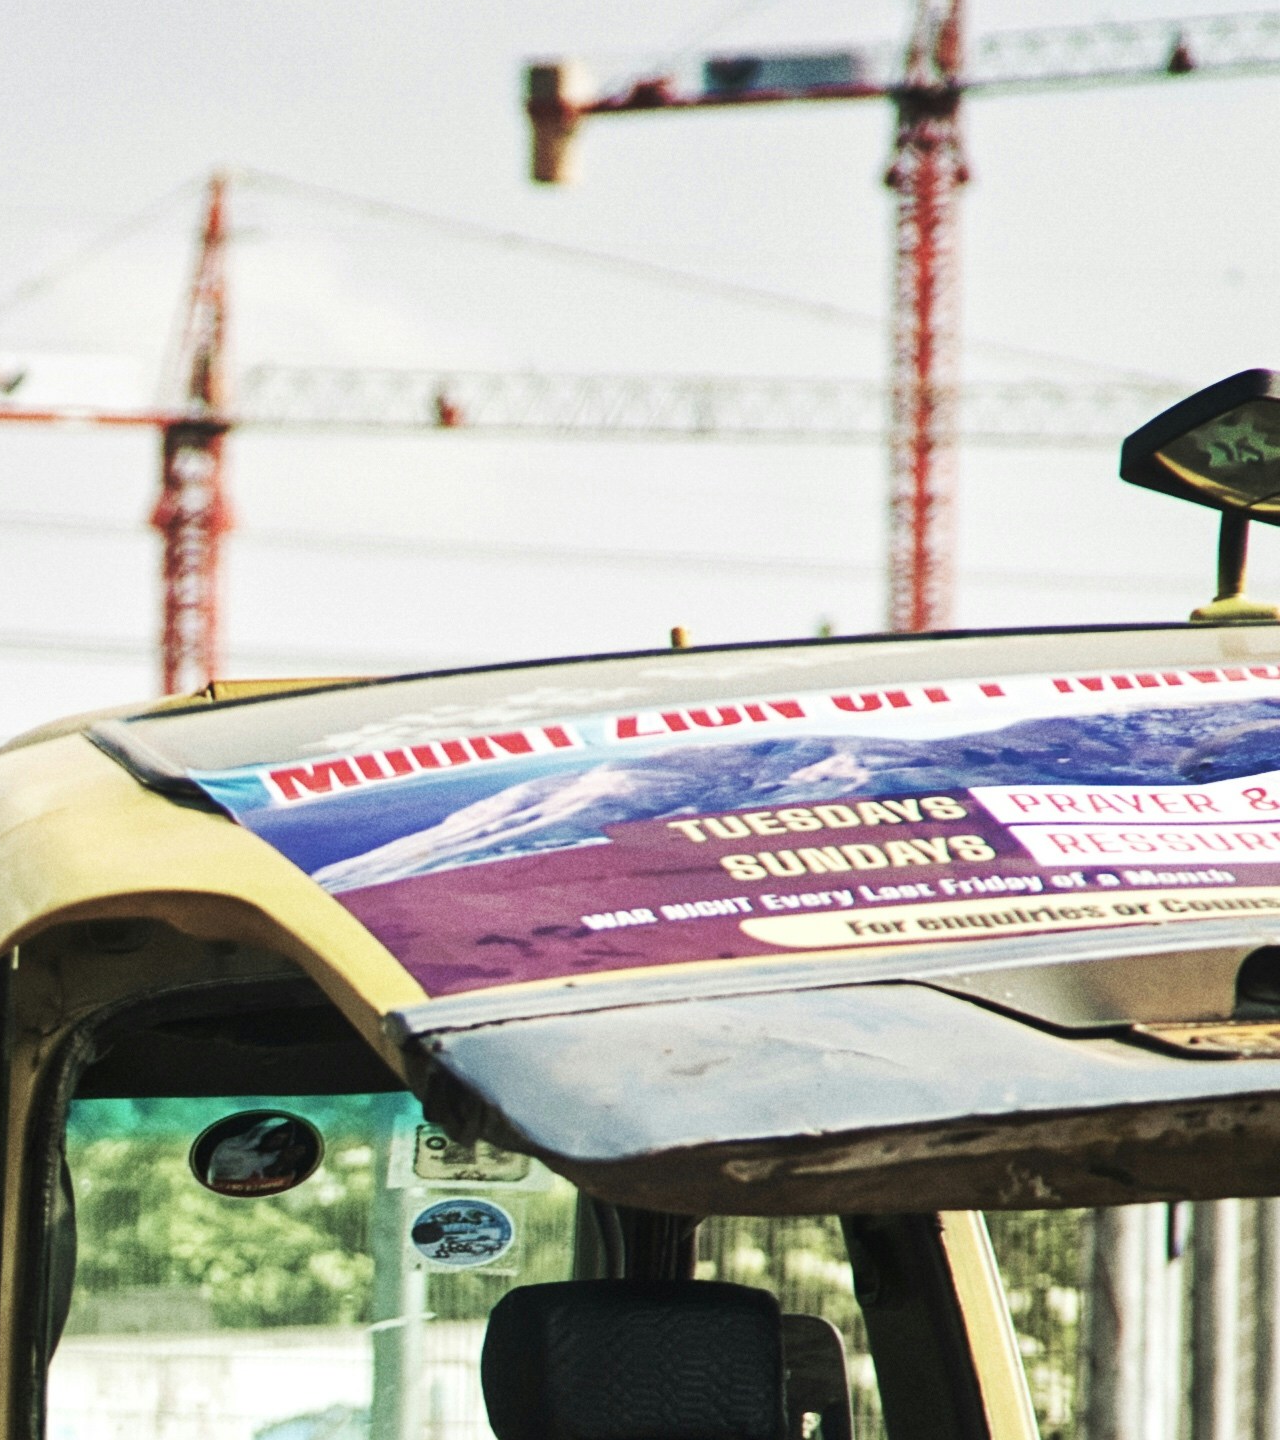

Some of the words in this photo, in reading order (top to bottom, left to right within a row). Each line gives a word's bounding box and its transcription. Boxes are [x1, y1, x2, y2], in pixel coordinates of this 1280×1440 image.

[667, 796, 968, 842] TUESDAYS
[1007, 793, 1223, 813] PRAYER
[1241, 787, 1280, 811] &
[720, 834, 996, 881] SUNDAYS
[1046, 831, 1280, 854] RESSUR
[581, 908, 658, 930] WAR
[660, 897, 754, 920] NIGHT
[759, 889, 854, 910] Every
[860, 883, 936, 902] Last
[939, 875, 1043, 895] Friday
[1051, 871, 1087, 888] of
[1096, 873, 1120, 887] a
[1122, 868, 1236, 886] Month
[846, 919, 907, 936] For
[916, 905, 1107, 930] enquiries
[1113, 903, 1151, 916] or
